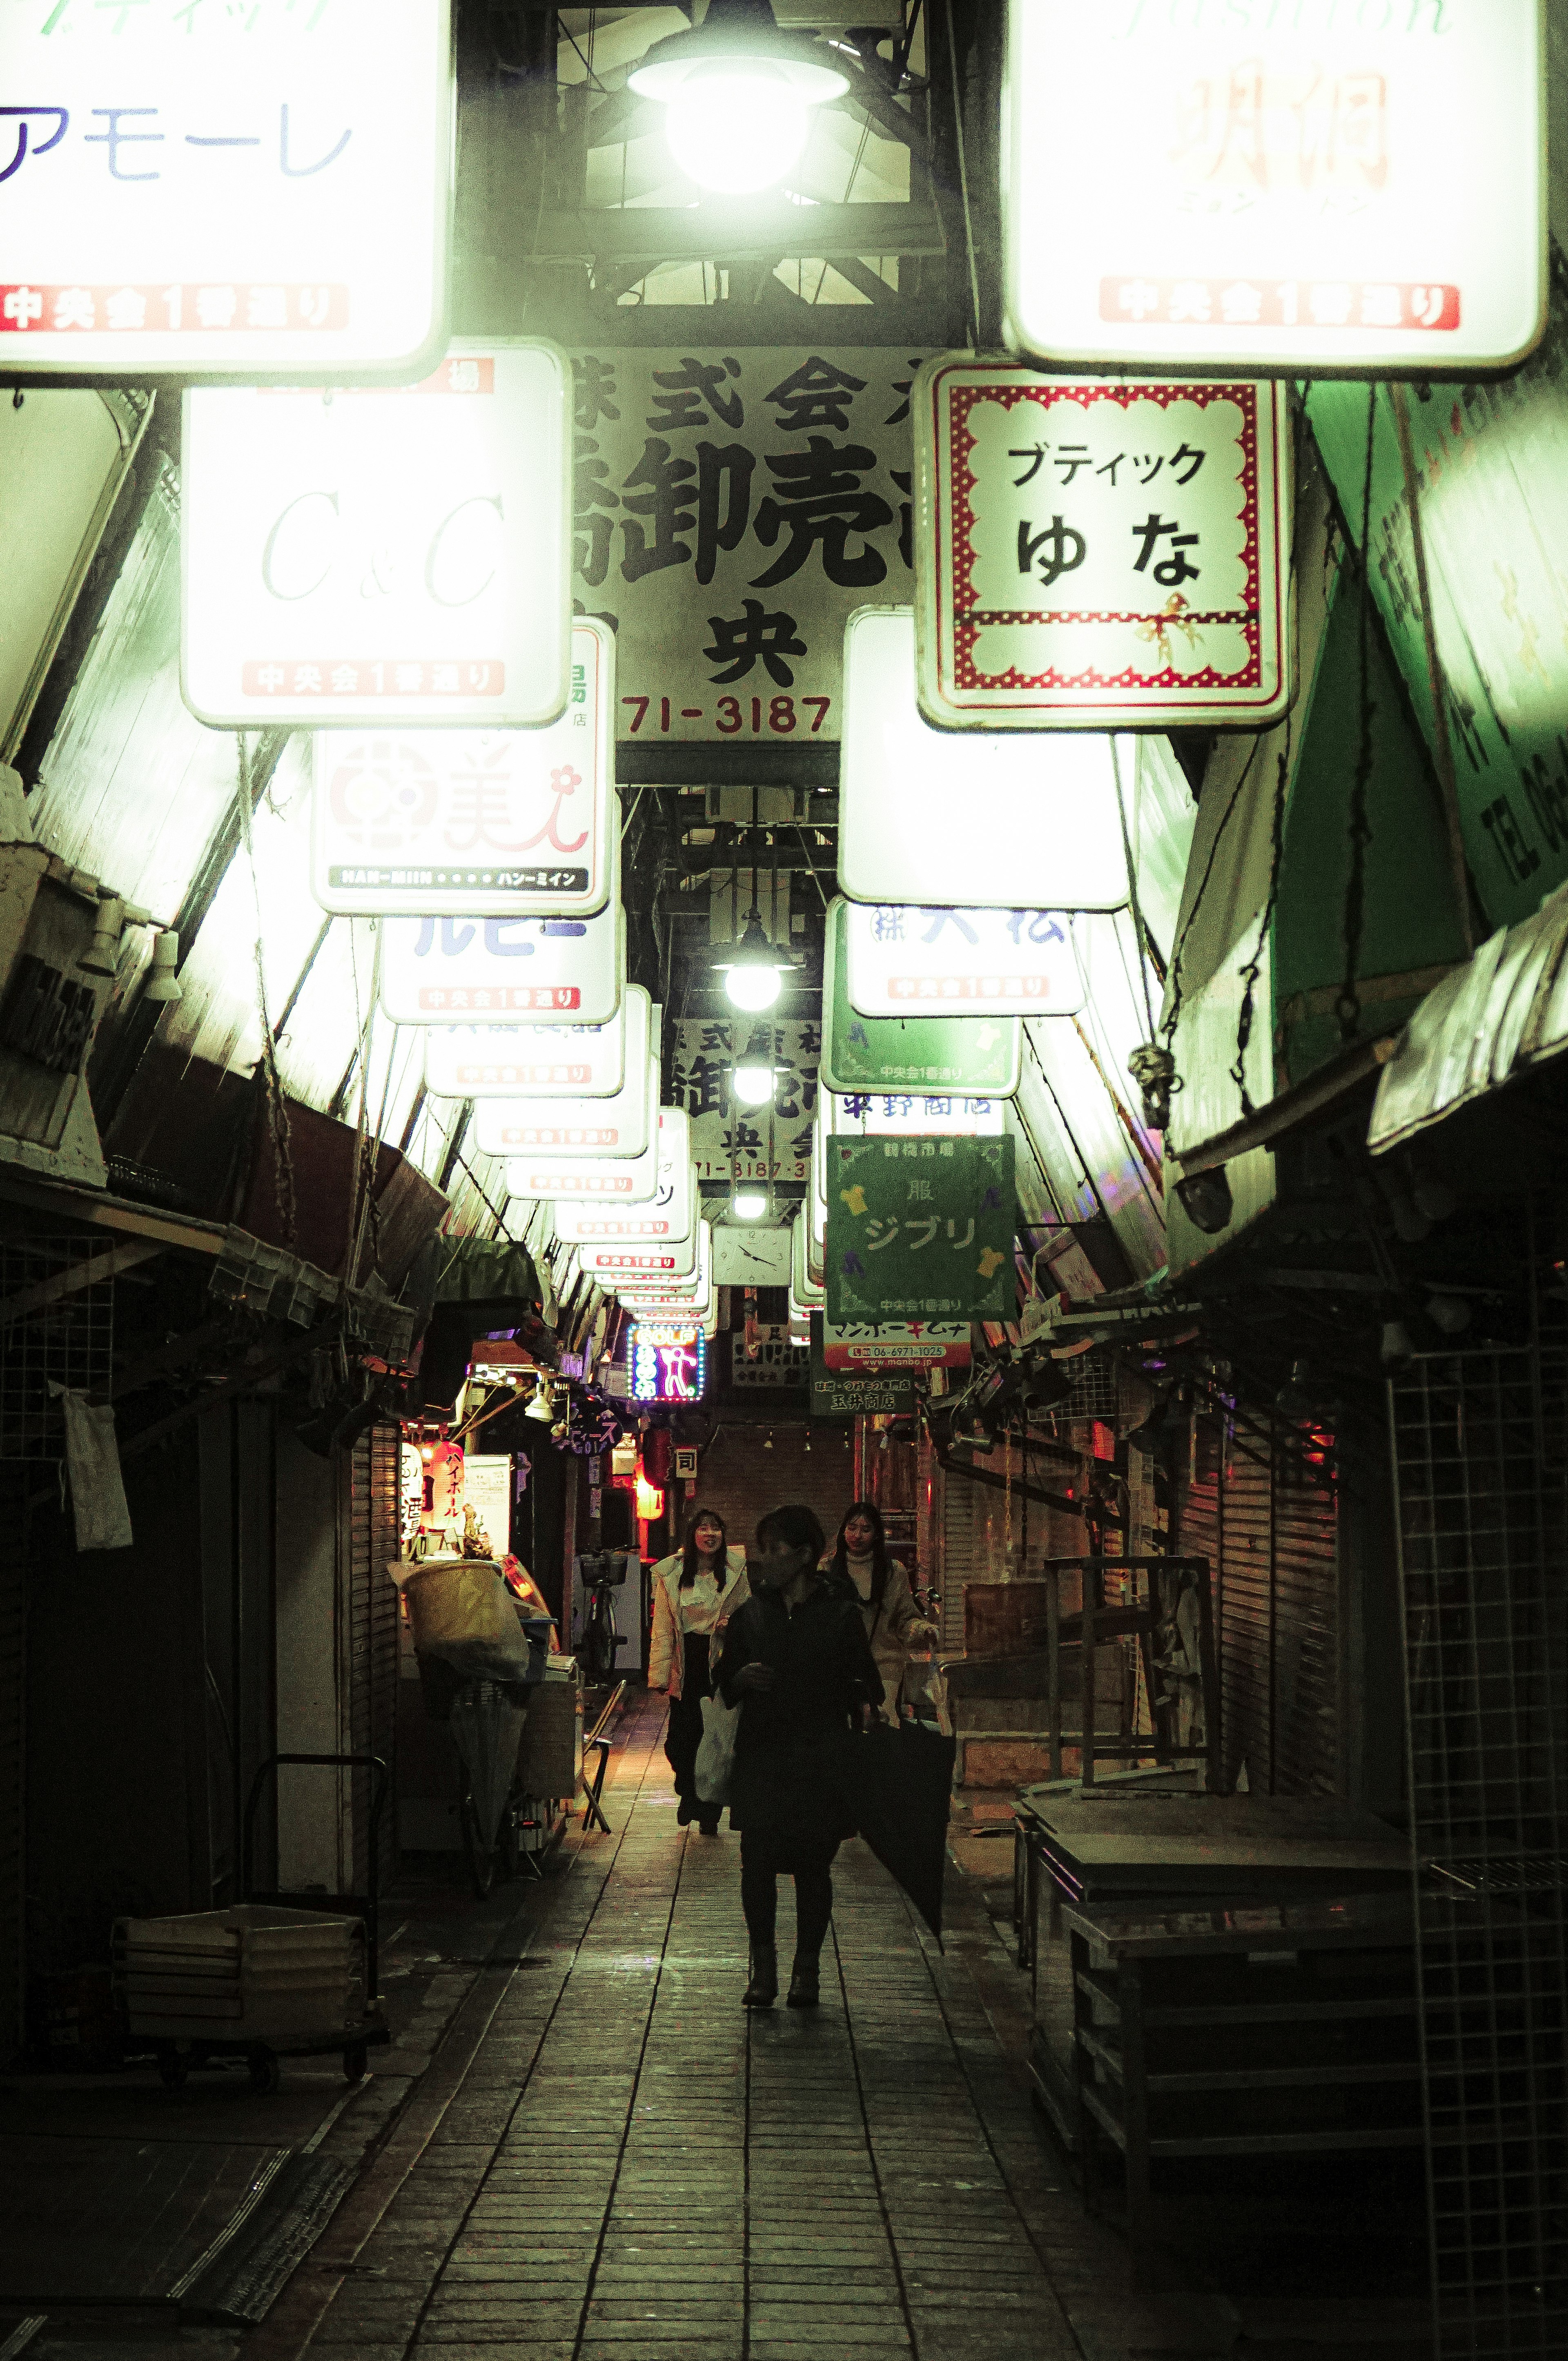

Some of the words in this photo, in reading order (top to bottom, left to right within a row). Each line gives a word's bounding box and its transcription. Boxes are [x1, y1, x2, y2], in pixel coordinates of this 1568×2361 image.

[1008, 441, 1207, 487] ブティック
[1017, 514, 1200, 586] ゆな
[341, 870, 432, 885] HAN-MIIN
[865, 1215, 975, 1250] ジブリ
[637, 1329, 695, 1346] GOLF
[874, 1347, 942, 1356] 06-6971-1025
